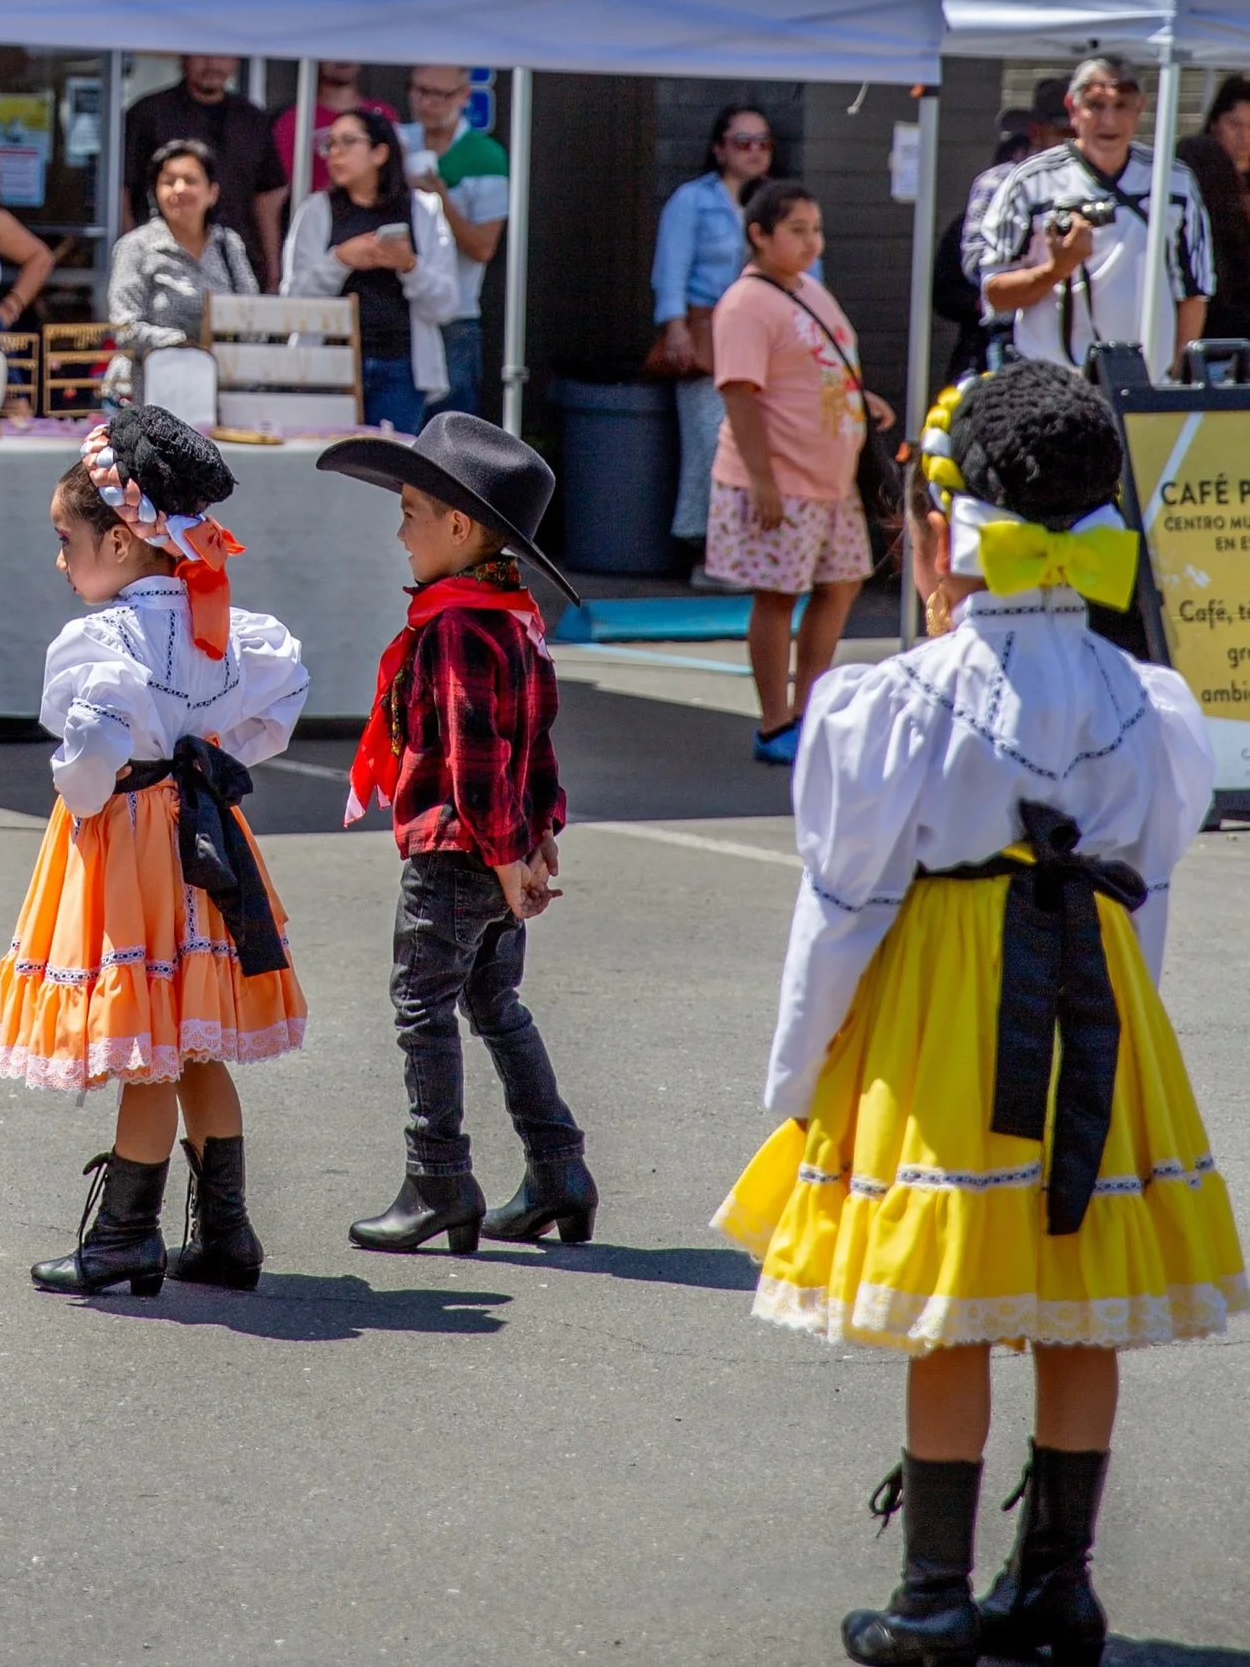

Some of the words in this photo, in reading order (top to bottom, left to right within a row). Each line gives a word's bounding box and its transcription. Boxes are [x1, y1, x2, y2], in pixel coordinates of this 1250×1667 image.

[1160, 472, 1229, 506] CAFÉ
[1164, 515, 1226, 533] CENTRO
[1215, 535, 1236, 552] EN
[1179, 599, 1233, 630] Café,
[1201, 679, 1250, 703] ambi
